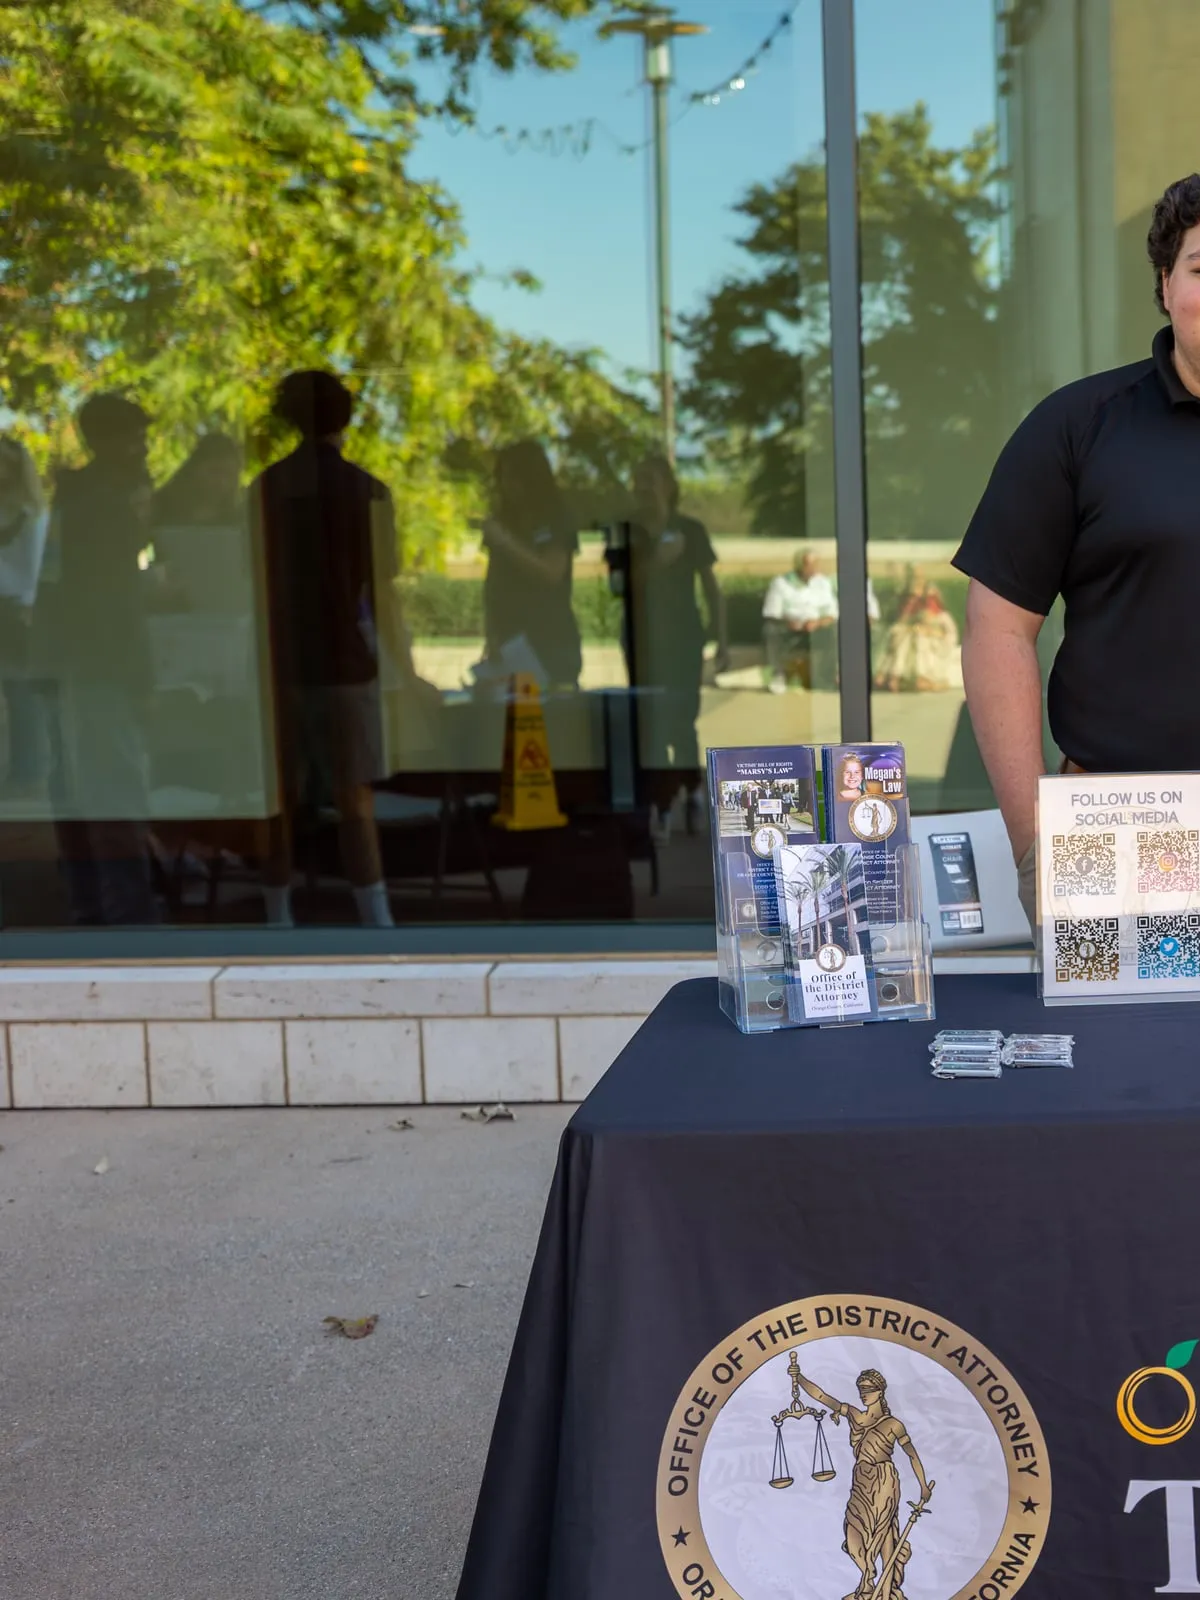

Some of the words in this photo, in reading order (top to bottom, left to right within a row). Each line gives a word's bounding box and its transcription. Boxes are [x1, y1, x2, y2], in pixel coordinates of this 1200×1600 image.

[864, 767, 901, 781] Megan's
[883, 780, 901, 793] Law
[1071, 792, 1133, 807] FOLLOW
[1137, 792, 1156, 805] US
[1160, 791, 1182, 804] ON
[1075, 813, 1128, 826] SOCIAL
[1132, 811, 1179, 825] MEDIA
[811, 973, 843, 983] Office
[846, 971, 857, 980] of
[805, 984, 821, 993] the
[825, 981, 864, 991] District
[814, 992, 858, 1003] Attorney
[667, 1387, 717, 1497] OFFICE
[711, 1348, 745, 1385] OF
[747, 1312, 808, 1353] THE
[814, 1305, 950, 1349] DISTRICT
[946, 1345, 1040, 1479] ATTORNEY
